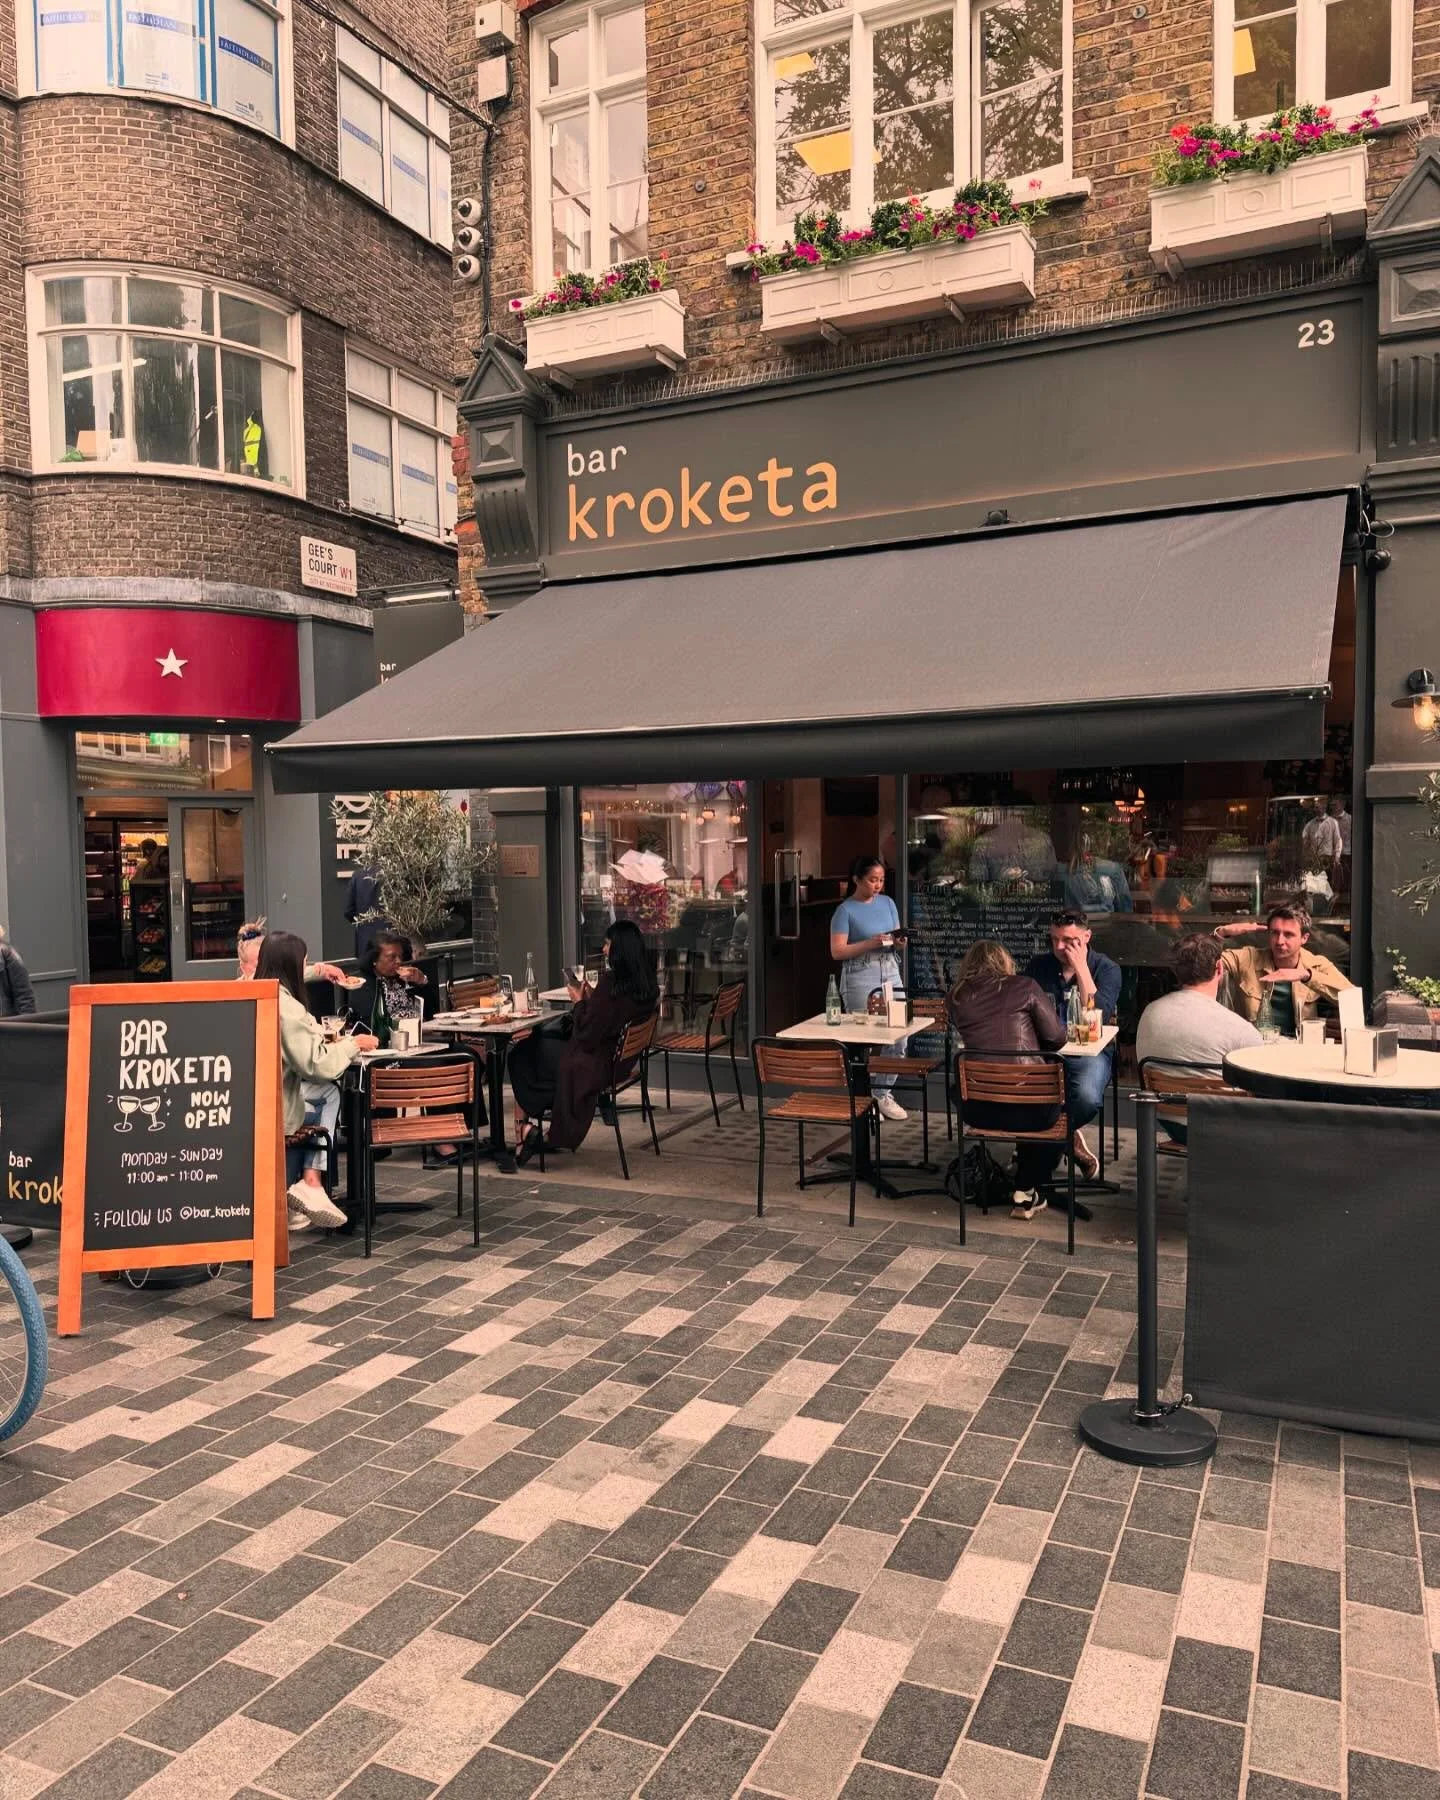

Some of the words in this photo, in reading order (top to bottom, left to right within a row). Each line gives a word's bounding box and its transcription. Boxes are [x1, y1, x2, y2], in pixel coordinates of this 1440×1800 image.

[1297, 319, 1335, 349] 23
[567, 443, 627, 477] bar
[568, 457, 838, 541] kroketa
[308, 543, 333, 561] GEE'S
[308, 558, 338, 577] COURT
[340, 567, 352, 580] W1
[379, 662, 397, 672] bar
[120, 1019, 168, 1056] BAR
[119, 1055, 232, 1090] KROKETA
[191, 1090, 230, 1107] NOW
[185, 1106, 231, 1129] OPEN
[8, 1150, 33, 1168] bar
[127, 1171, 155, 1184] 11:00
[156, 1174, 168, 1182] am
[179, 1169, 203, 1181] 11:00
[205, 1174, 218, 1182] pm
[103, 1208, 151, 1228] FOLLOW
[157, 1207, 172, 1223] US
[180, 1204, 250, 1220] @bar_kroketa
